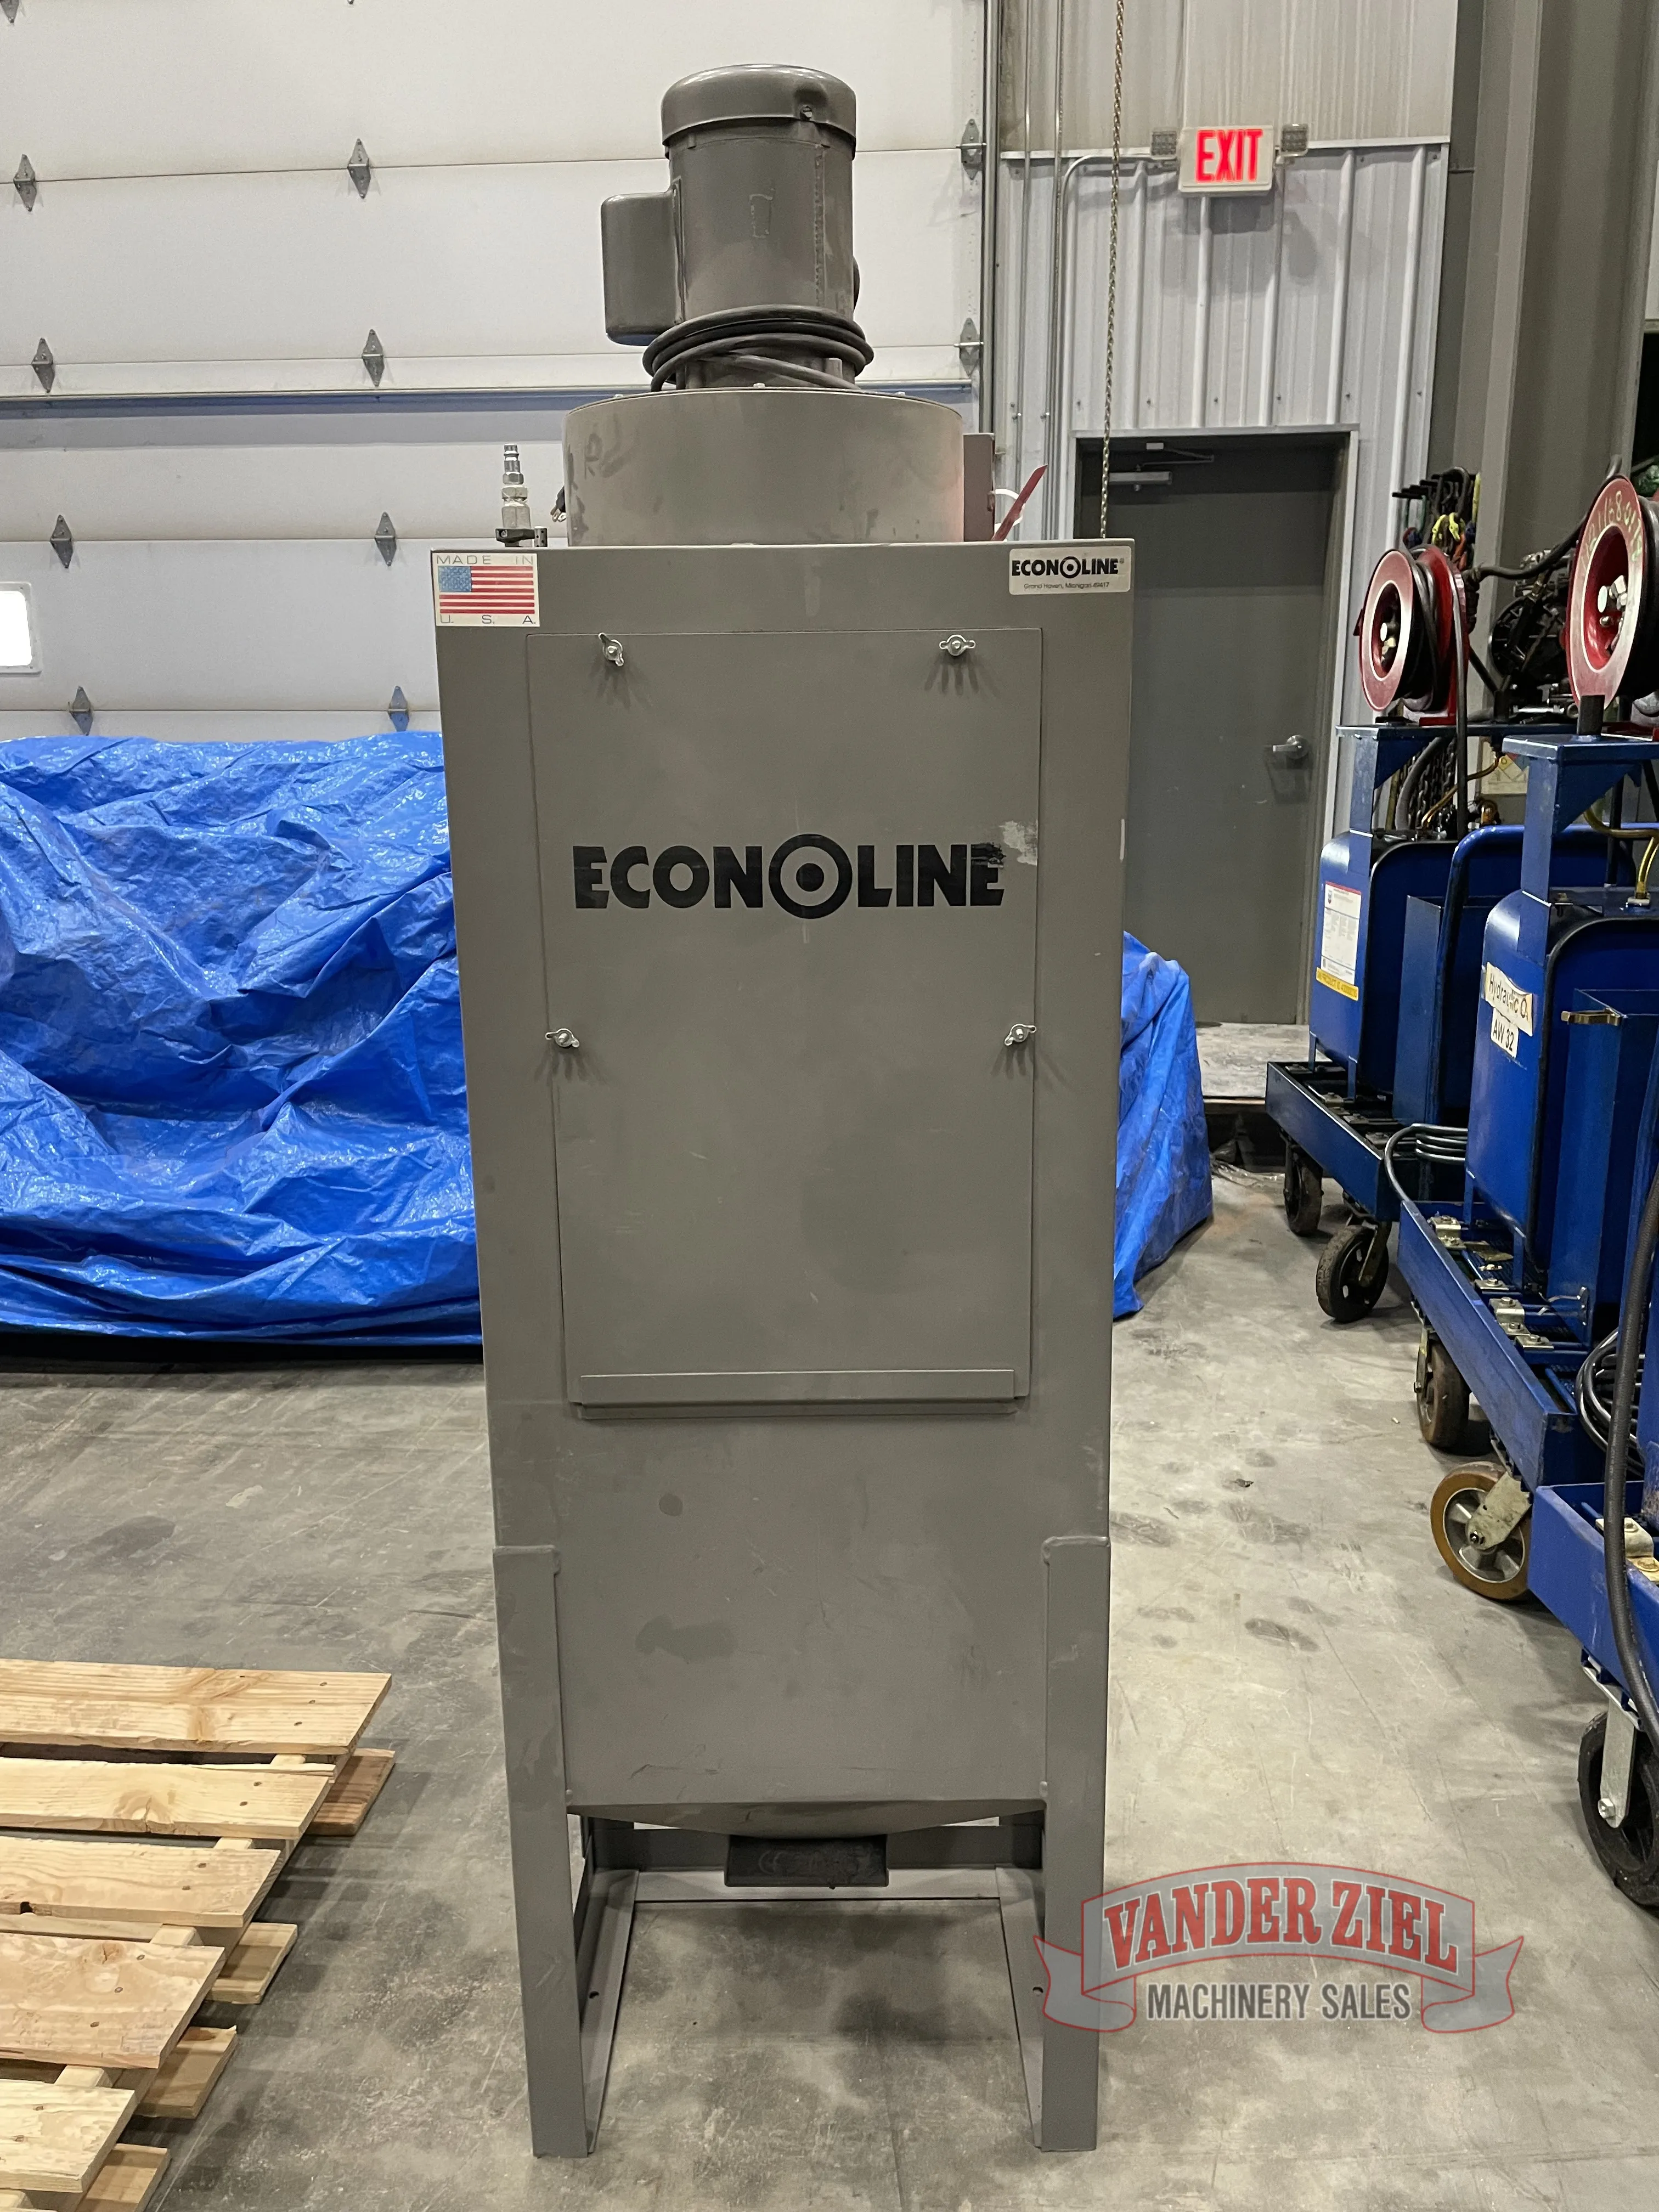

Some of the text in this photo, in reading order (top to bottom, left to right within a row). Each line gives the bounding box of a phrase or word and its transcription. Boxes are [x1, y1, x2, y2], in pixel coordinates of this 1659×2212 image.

[1195, 129, 1263, 183] EXIT
[437, 555, 534, 565] MADE IN
[1012, 556, 1119, 579] ECONOLINE
[573, 833, 1007, 919] ECONOLINE
[1493, 1019, 1514, 1052] AW 32
